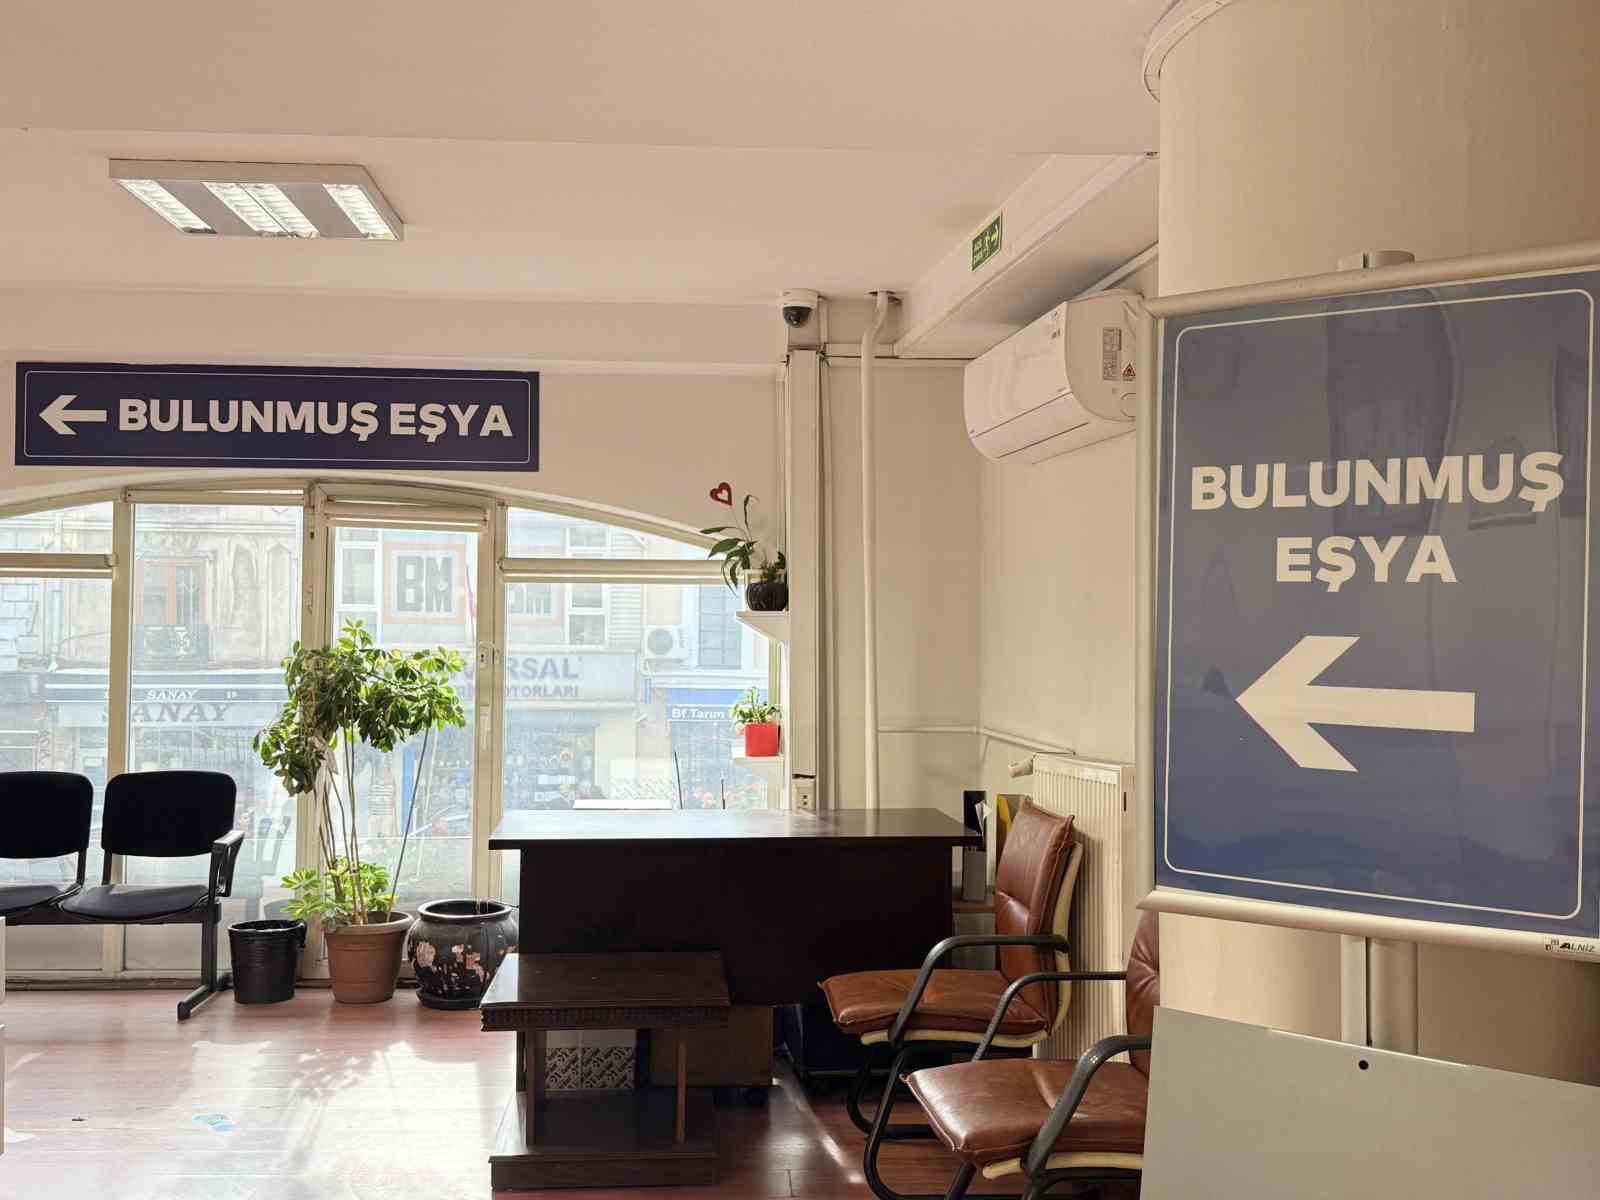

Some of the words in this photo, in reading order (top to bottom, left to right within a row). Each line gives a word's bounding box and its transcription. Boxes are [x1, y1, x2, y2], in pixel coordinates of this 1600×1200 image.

[119, 398, 378, 442] BULUNMUŞ
[390, 402, 513, 443] EŞYA
[1191, 450, 1565, 513] BULUNMUŞ
[397, 556, 453, 612] BM
[1276, 535, 1458, 593] EŞYA
[103, 702, 234, 722] ANAY
[146, 689, 198, 700] SANAY
